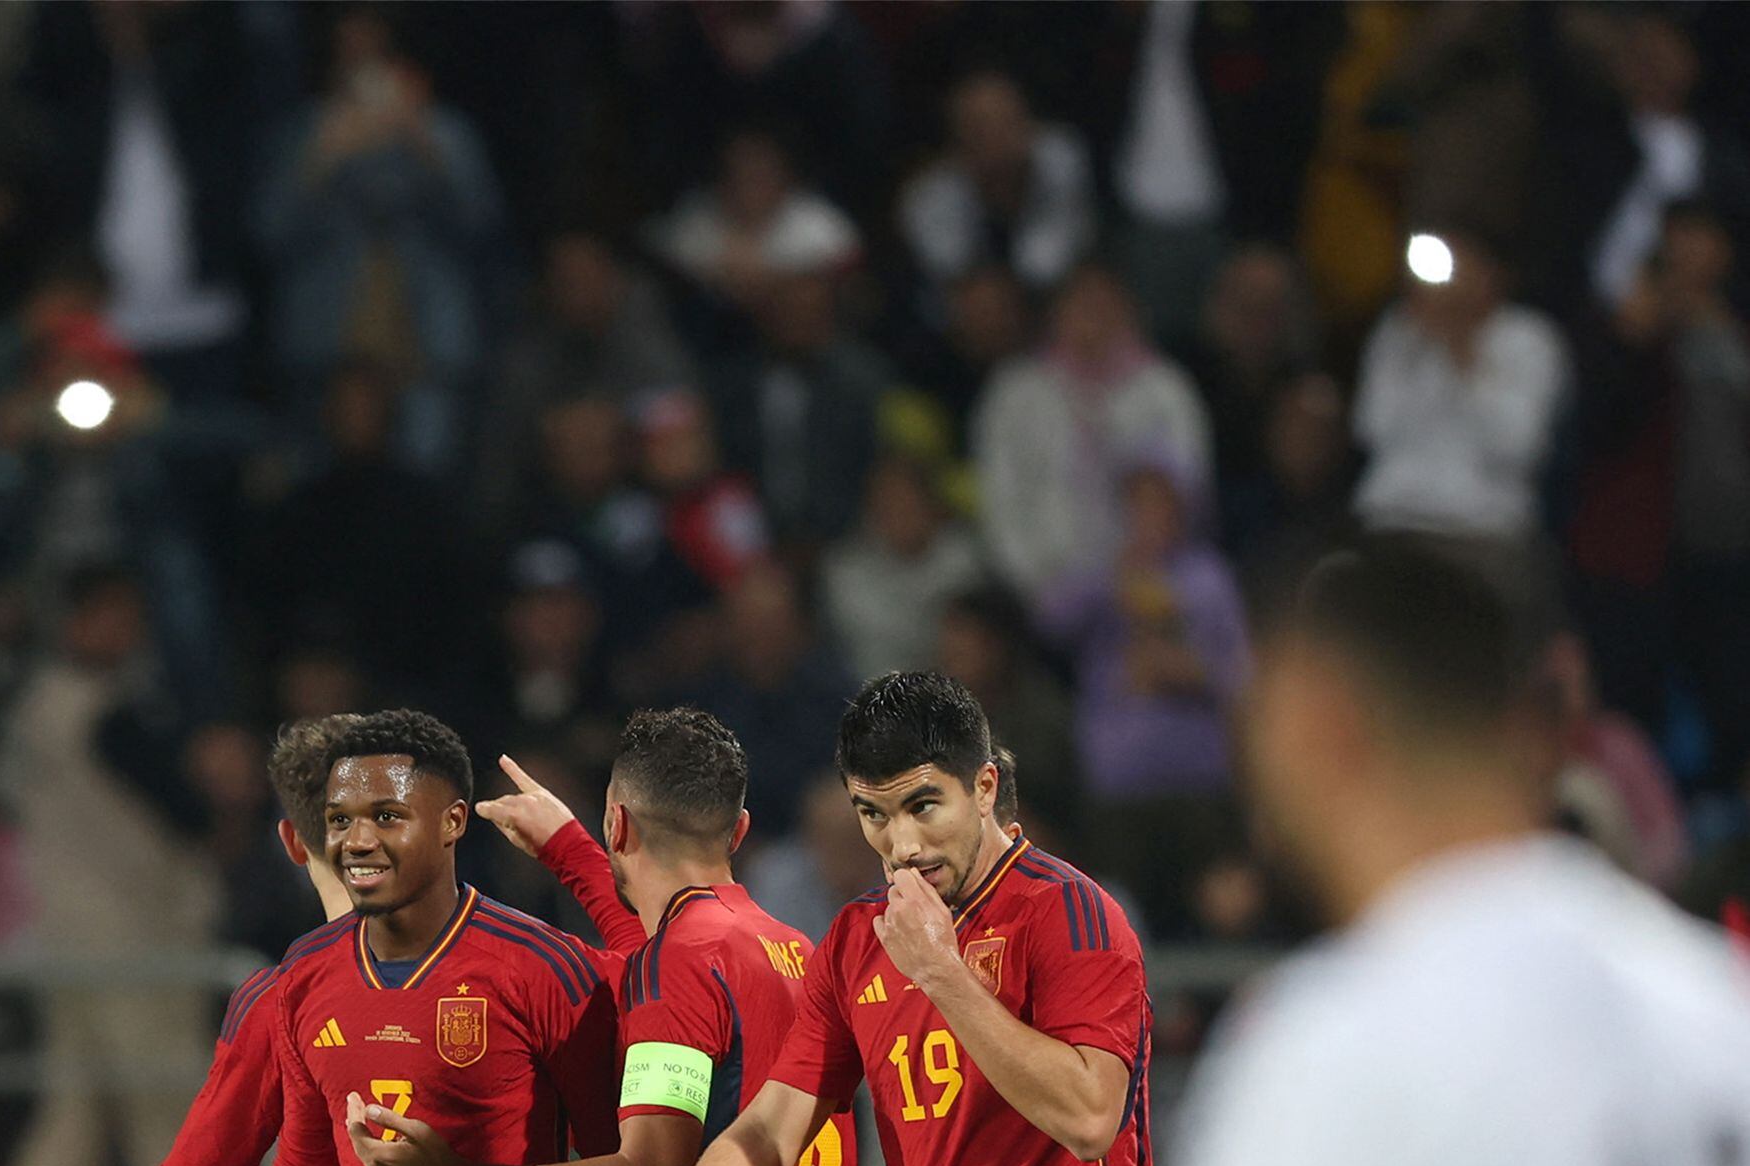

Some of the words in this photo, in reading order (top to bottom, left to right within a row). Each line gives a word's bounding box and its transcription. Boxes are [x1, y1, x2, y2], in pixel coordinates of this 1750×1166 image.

[663, 1063, 682, 1074] NO
[684, 1066, 699, 1080] TO
[887, 1029, 964, 1122] 19
[371, 1080, 413, 1142] 7
